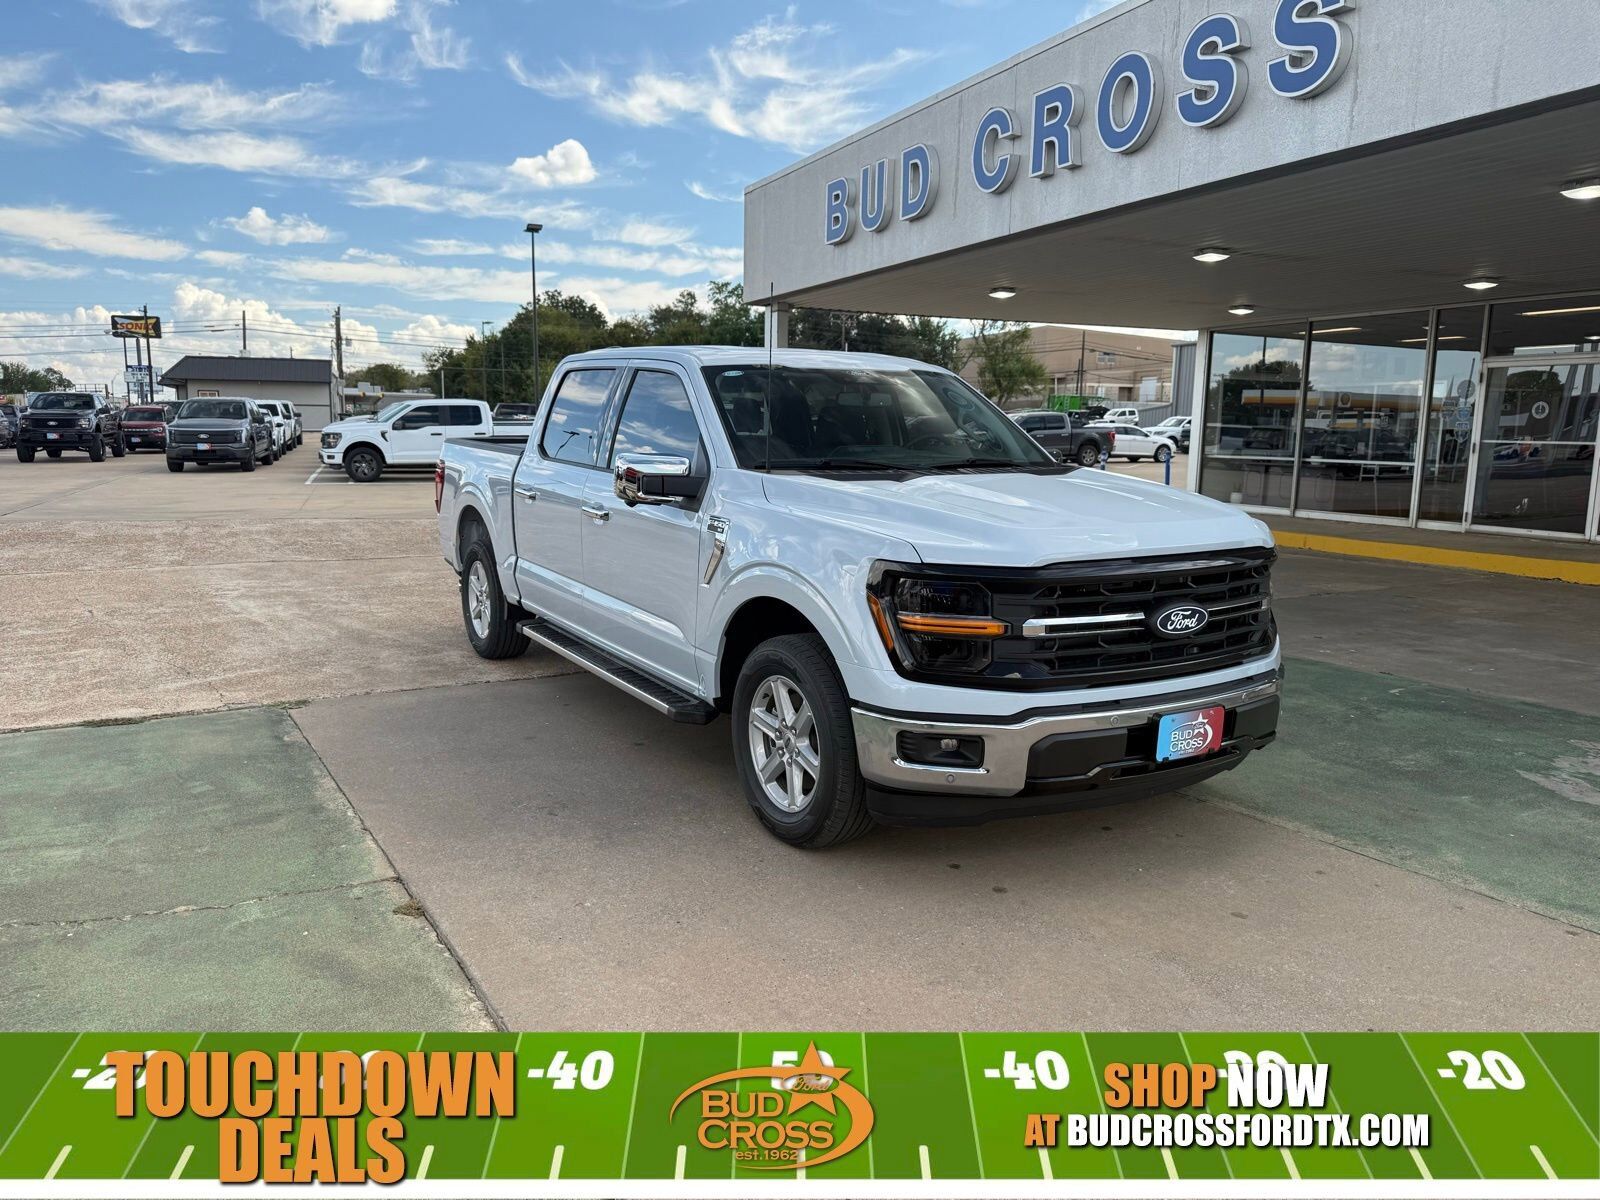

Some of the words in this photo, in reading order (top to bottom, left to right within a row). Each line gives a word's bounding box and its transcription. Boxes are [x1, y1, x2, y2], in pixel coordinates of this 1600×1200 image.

[825, 143, 940, 245] BUD
[971, 0, 1356, 194] CROSS
[1167, 610, 1199, 630] Ford
[1170, 729, 1193, 742] BUD
[1169, 737, 1204, 752] CROSS
